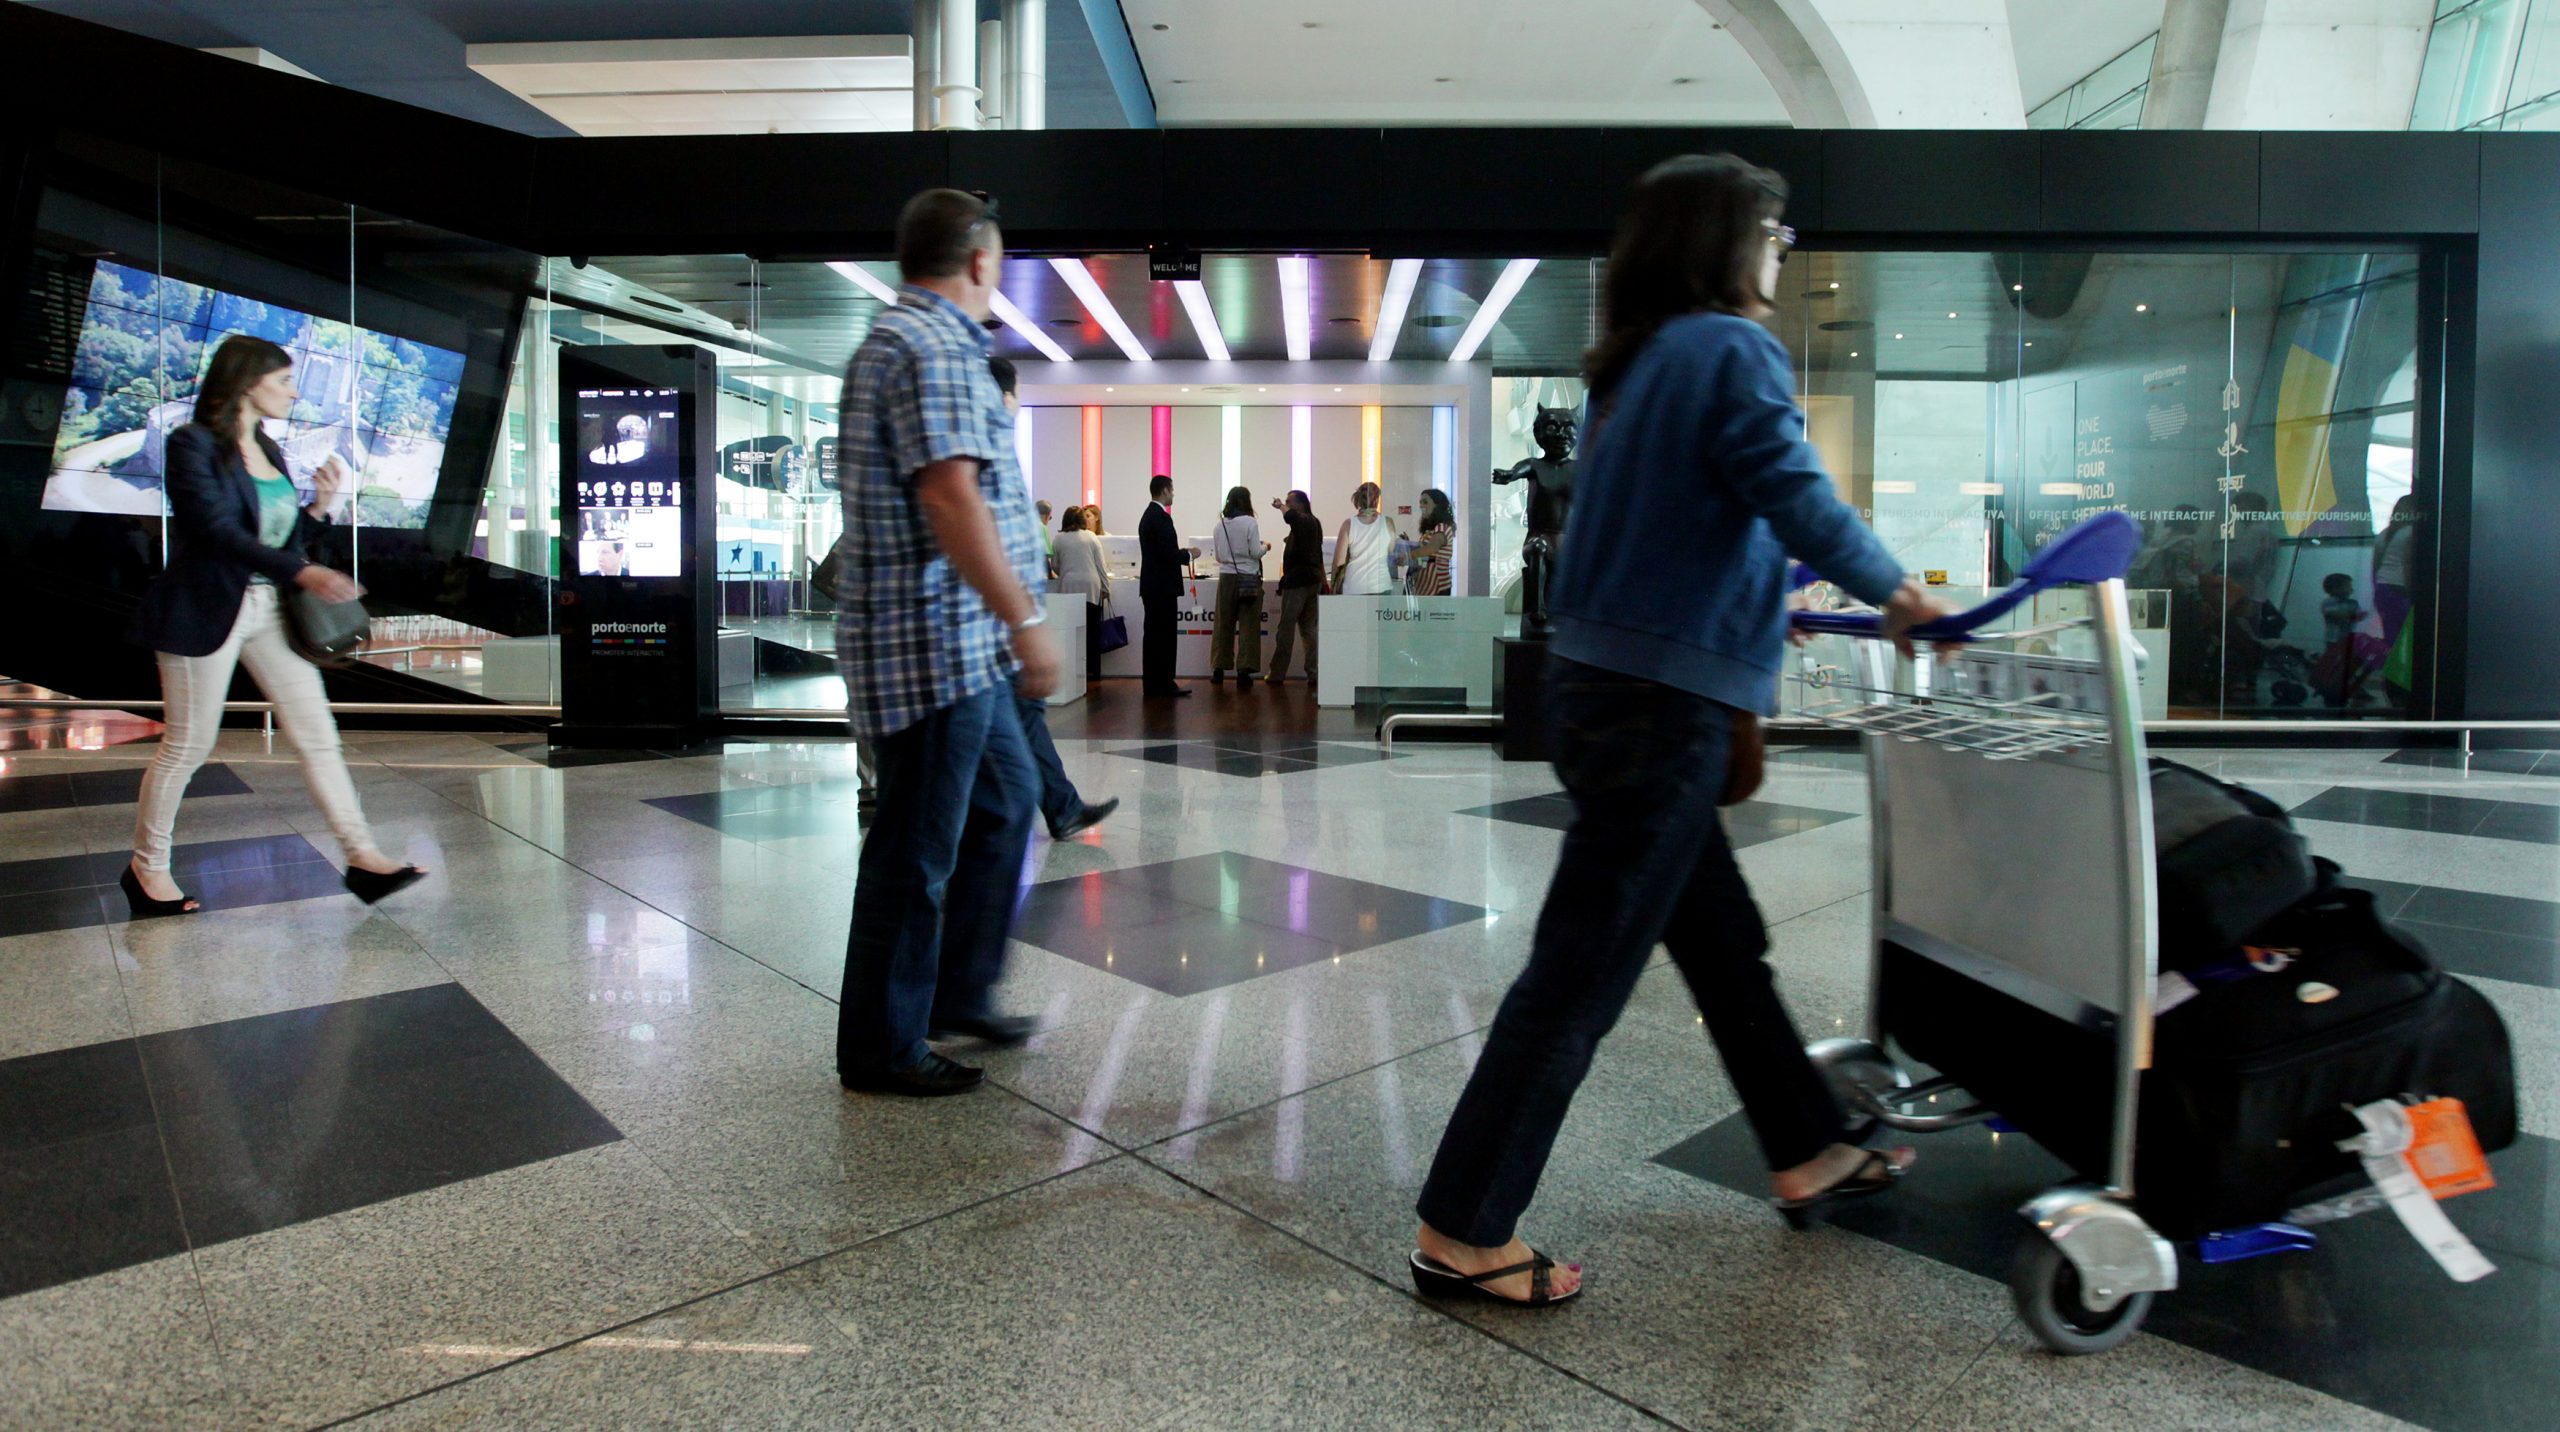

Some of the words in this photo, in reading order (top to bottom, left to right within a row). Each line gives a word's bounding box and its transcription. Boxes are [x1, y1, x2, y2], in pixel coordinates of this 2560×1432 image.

[2078, 416, 2100, 435] ONE
[2078, 437, 2114, 456] PLACE,
[2077, 461, 2105, 479] FOUR
[2076, 482, 2115, 501] WORLD
[2029, 510, 2068, 520] OFFICE
[2150, 511, 2215, 521] INTERACTIF
[591, 621, 666, 636] portoenorte
